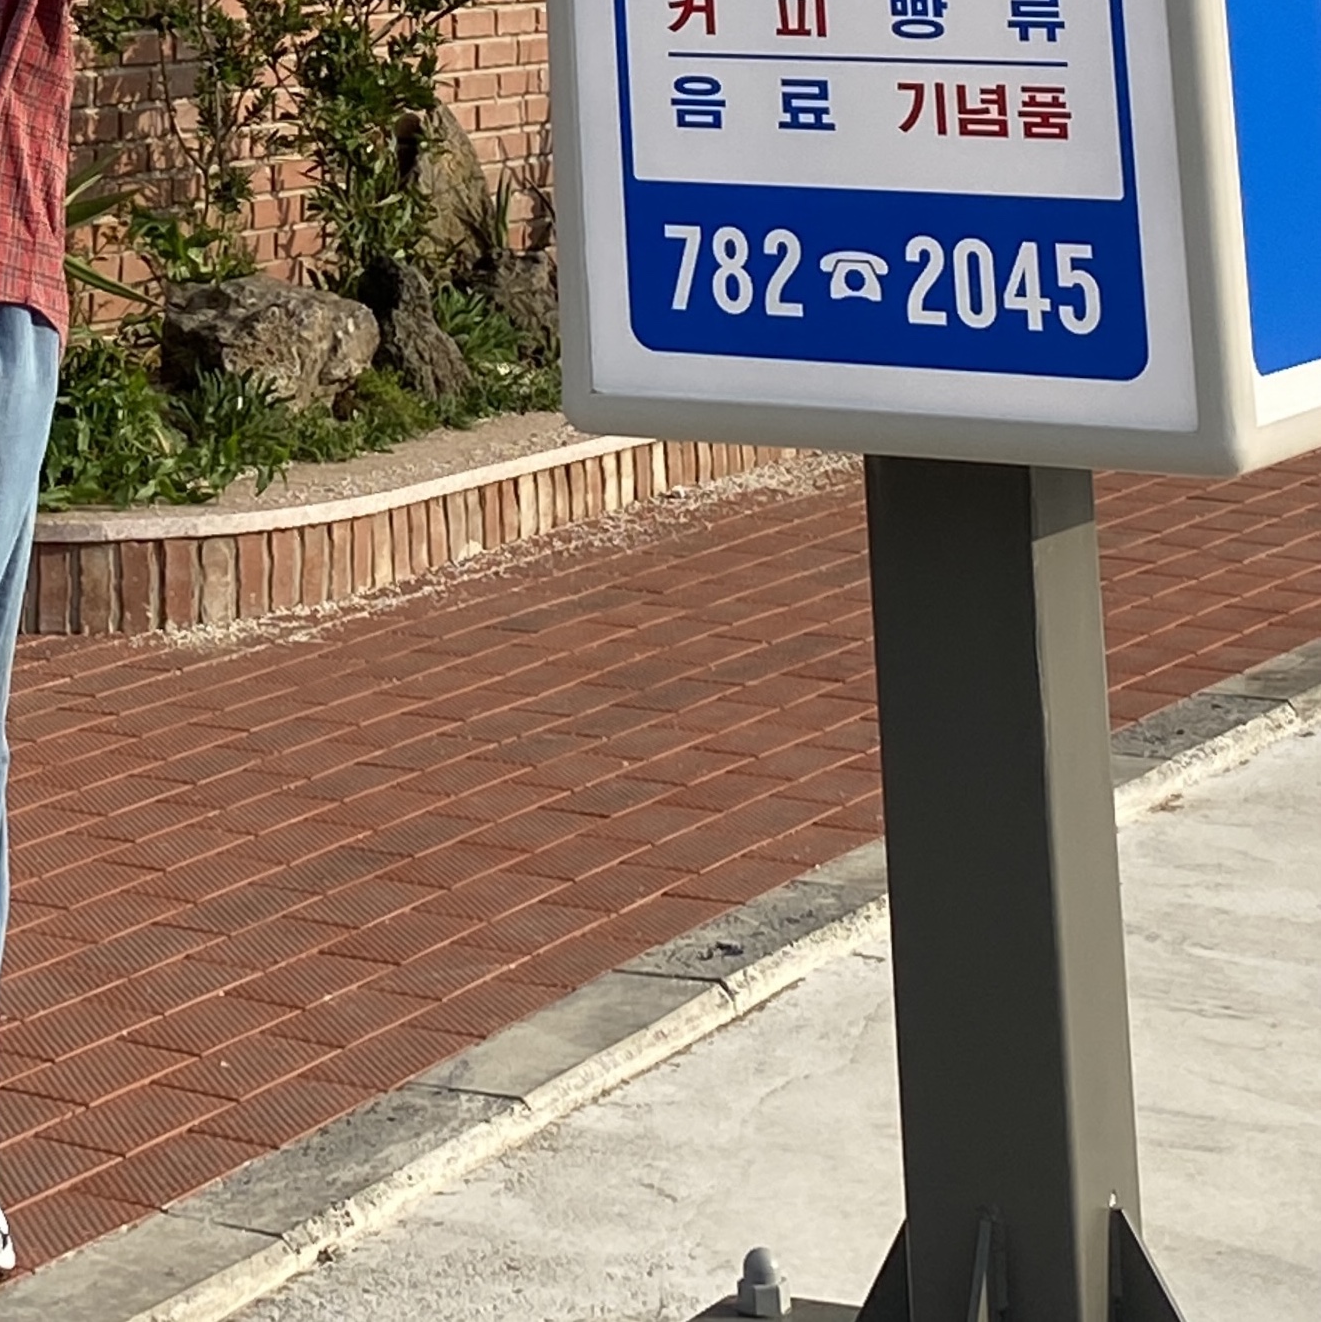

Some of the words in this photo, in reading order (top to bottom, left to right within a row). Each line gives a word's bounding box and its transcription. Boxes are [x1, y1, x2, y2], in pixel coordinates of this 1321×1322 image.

[897, 82, 1073, 141] 기념품
[663, 224, 805, 318] 782
[904, 235, 1102, 335] 2045
